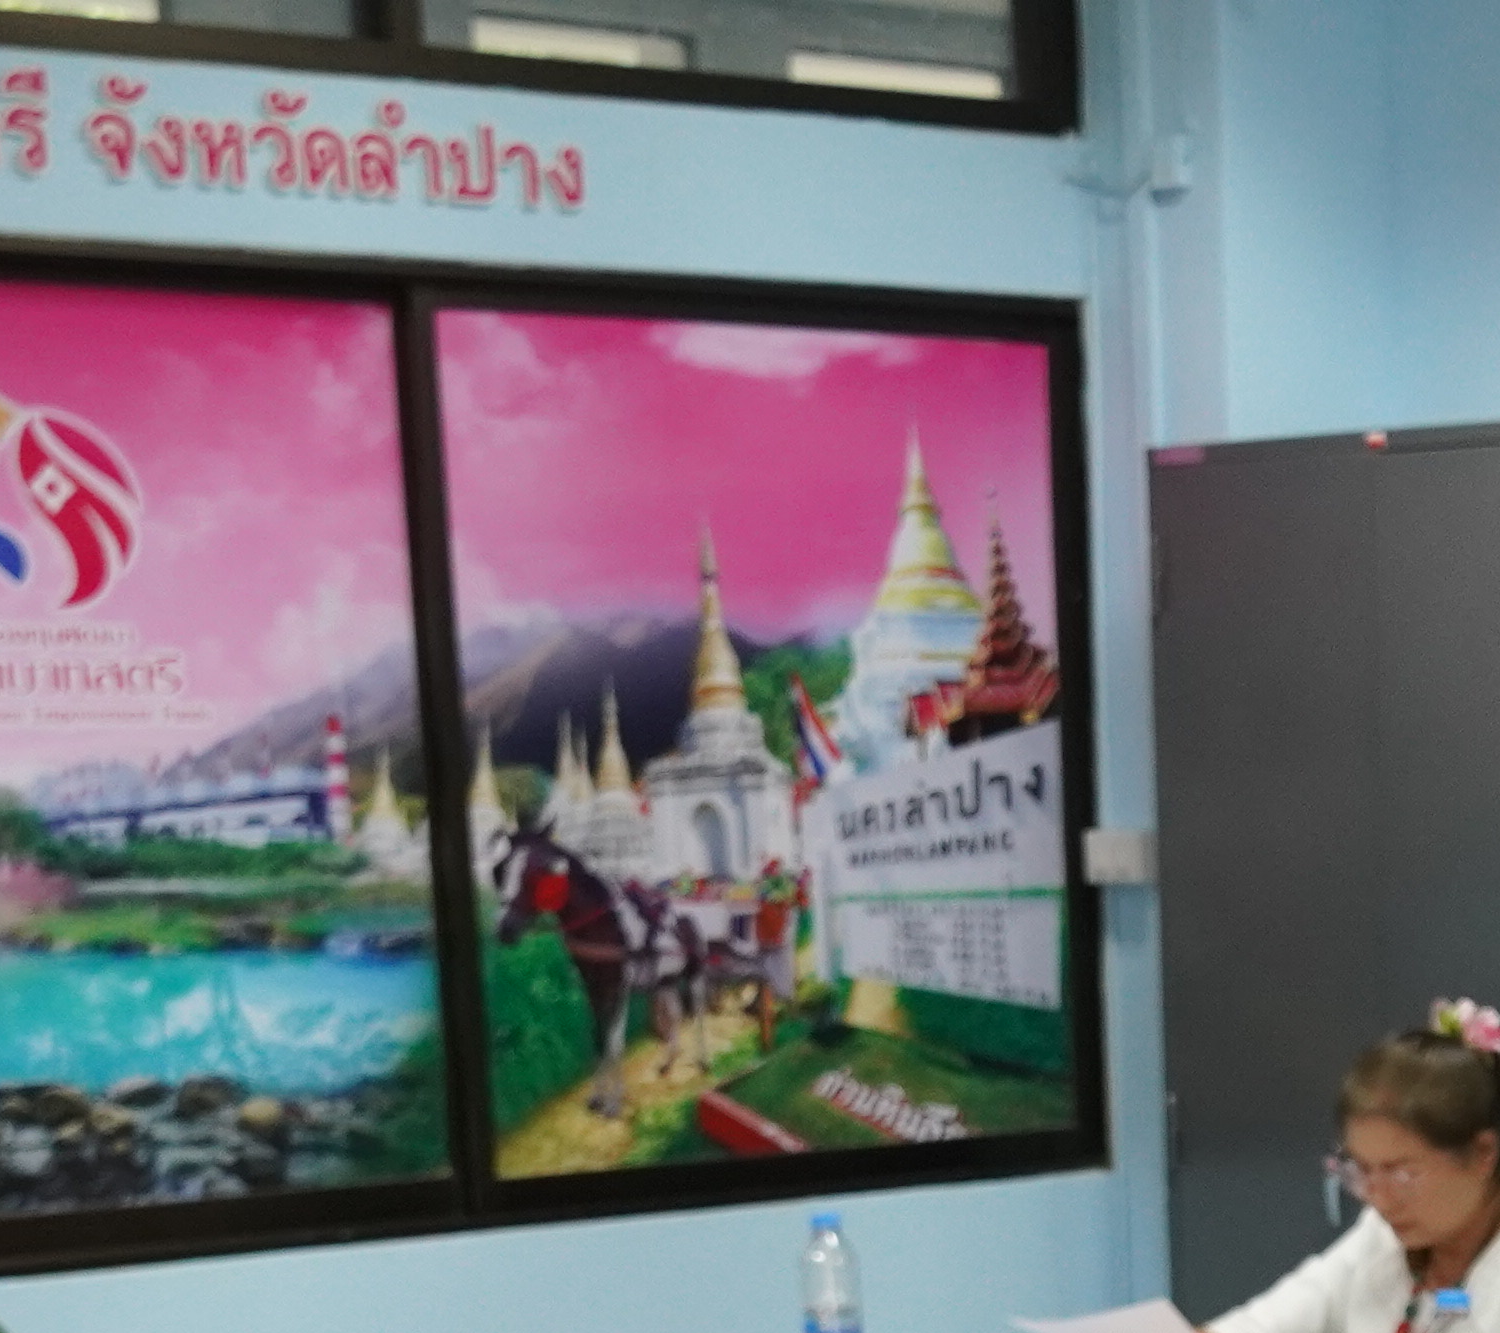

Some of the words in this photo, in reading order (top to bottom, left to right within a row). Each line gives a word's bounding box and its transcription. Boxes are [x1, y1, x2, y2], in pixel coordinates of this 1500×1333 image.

[88, 80, 584, 207] จังหวัดลำปาง
